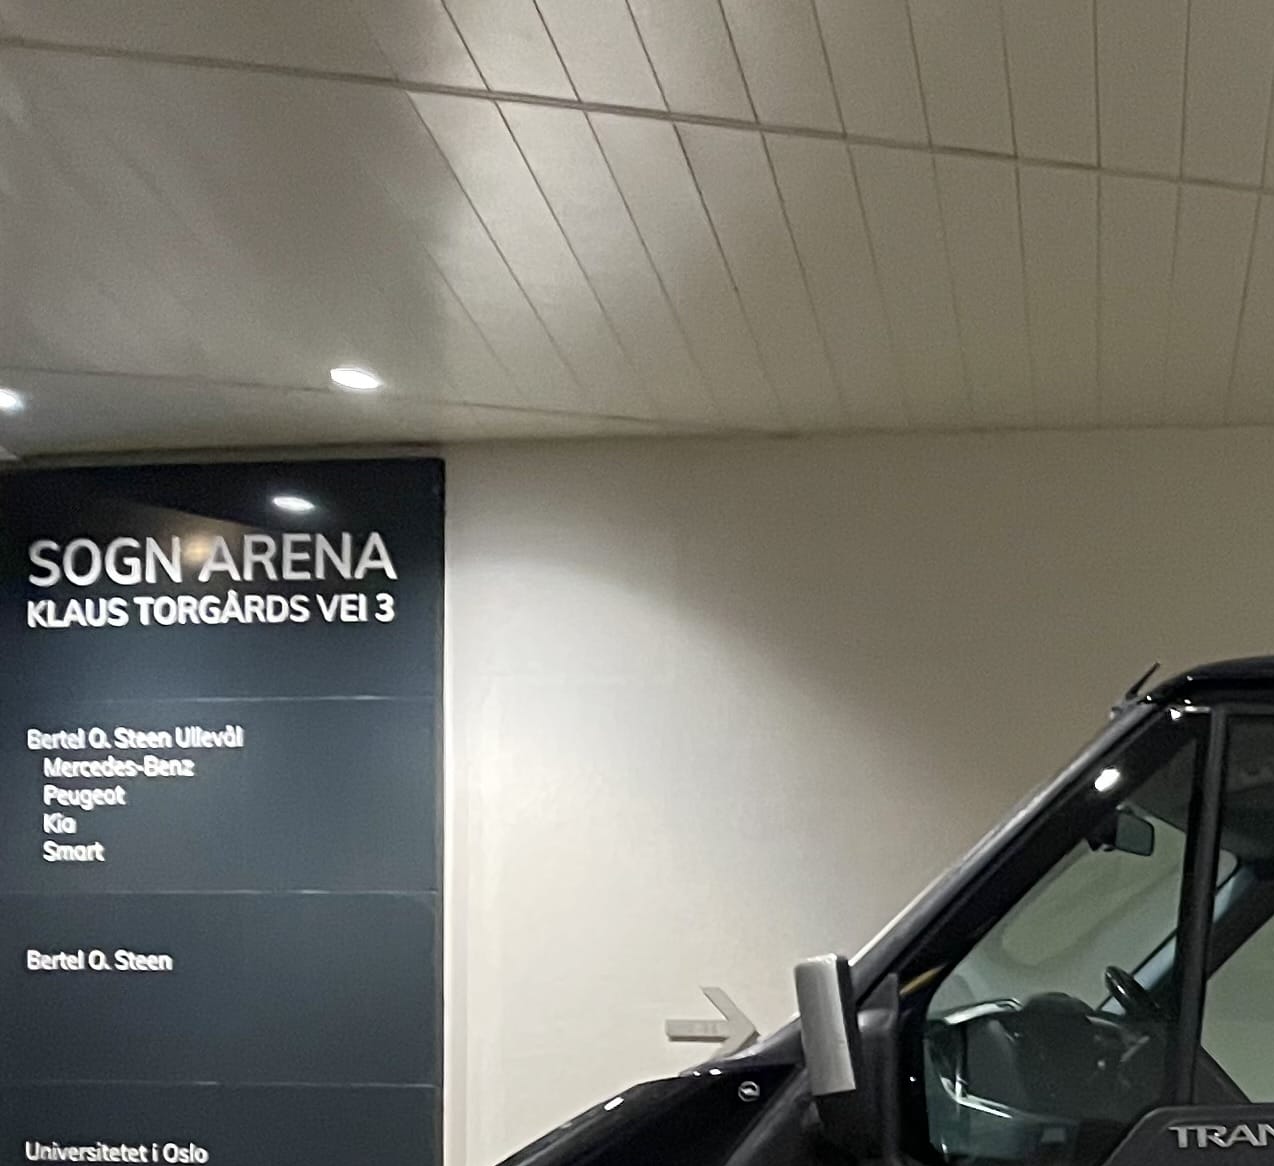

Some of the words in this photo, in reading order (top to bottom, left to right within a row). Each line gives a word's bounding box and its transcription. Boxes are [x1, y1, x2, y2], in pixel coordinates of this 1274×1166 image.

[28, 535, 183, 588] SOGN
[198, 531, 399, 583] ARENA
[27, 597, 130, 628] KLAUS
[134, 589, 311, 627] TORGÅRDS
[316, 593, 368, 622] VEI
[374, 592, 396, 623] 3
[27, 727, 86, 750] Bertel
[88, 727, 111, 750] O.
[114, 726, 173, 749] Steen
[175, 724, 245, 749] Ullevål
[43, 755, 196, 779] Mercedes-Benz
[43, 784, 127, 811] Peugeot
[43, 812, 77, 834] Kia
[42, 840, 105, 862] Smart
[27, 948, 85, 971] Bertel
[88, 949, 111, 971] O.
[114, 948, 174, 971] Steen
[25, 1141, 149, 1163] Universitetet
[151, 1142, 159, 1163] i
[162, 1142, 210, 1164] Oslo
